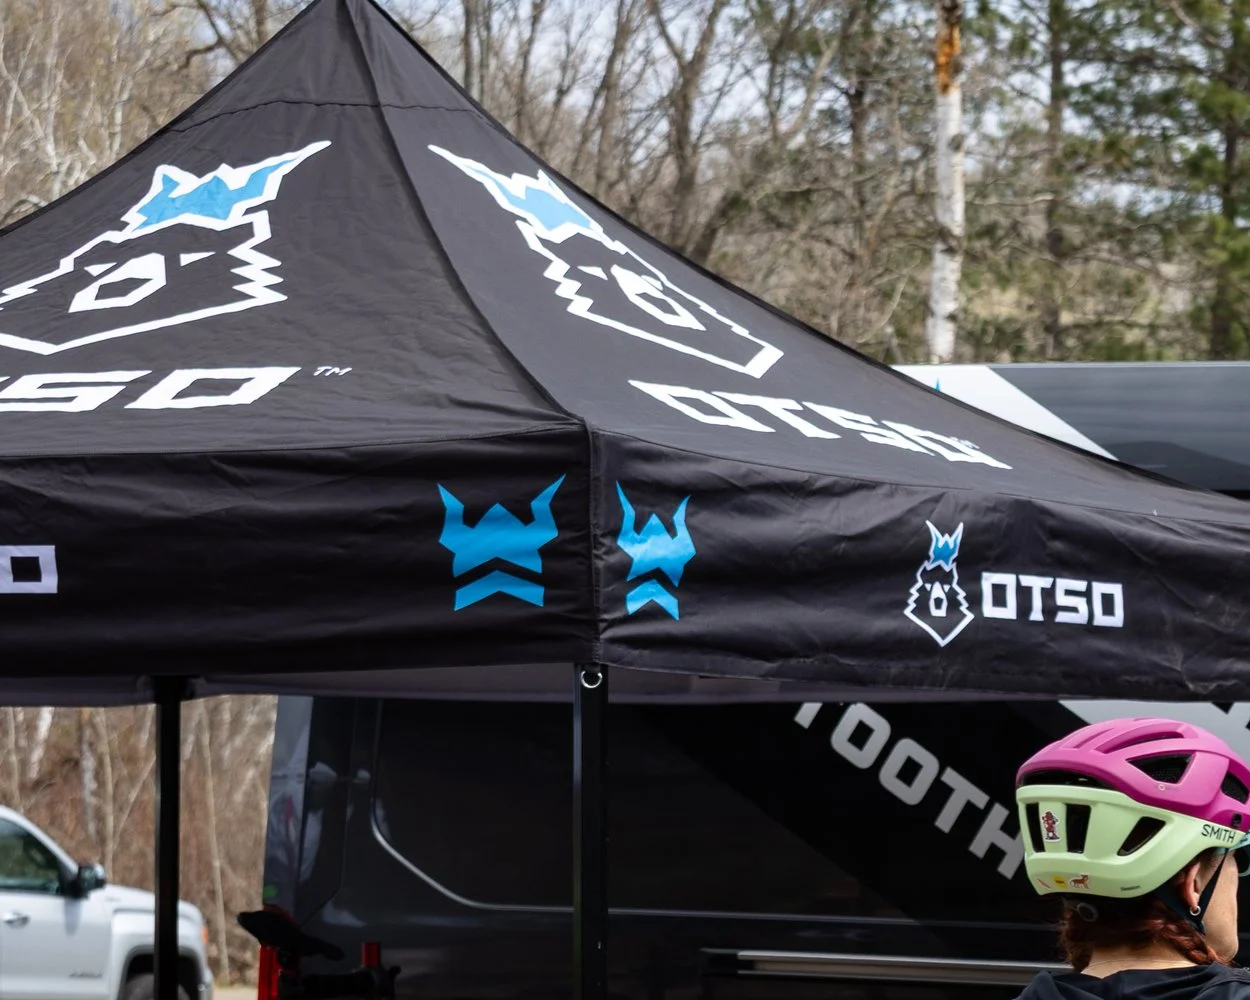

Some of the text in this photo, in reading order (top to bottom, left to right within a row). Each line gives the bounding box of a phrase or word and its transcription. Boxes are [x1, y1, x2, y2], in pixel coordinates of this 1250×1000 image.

[0, 367, 302, 412] SO
[627, 379, 1014, 470] OTSO
[980, 571, 1125, 628] OTSO
[1201, 823, 1237, 844] SMITH
